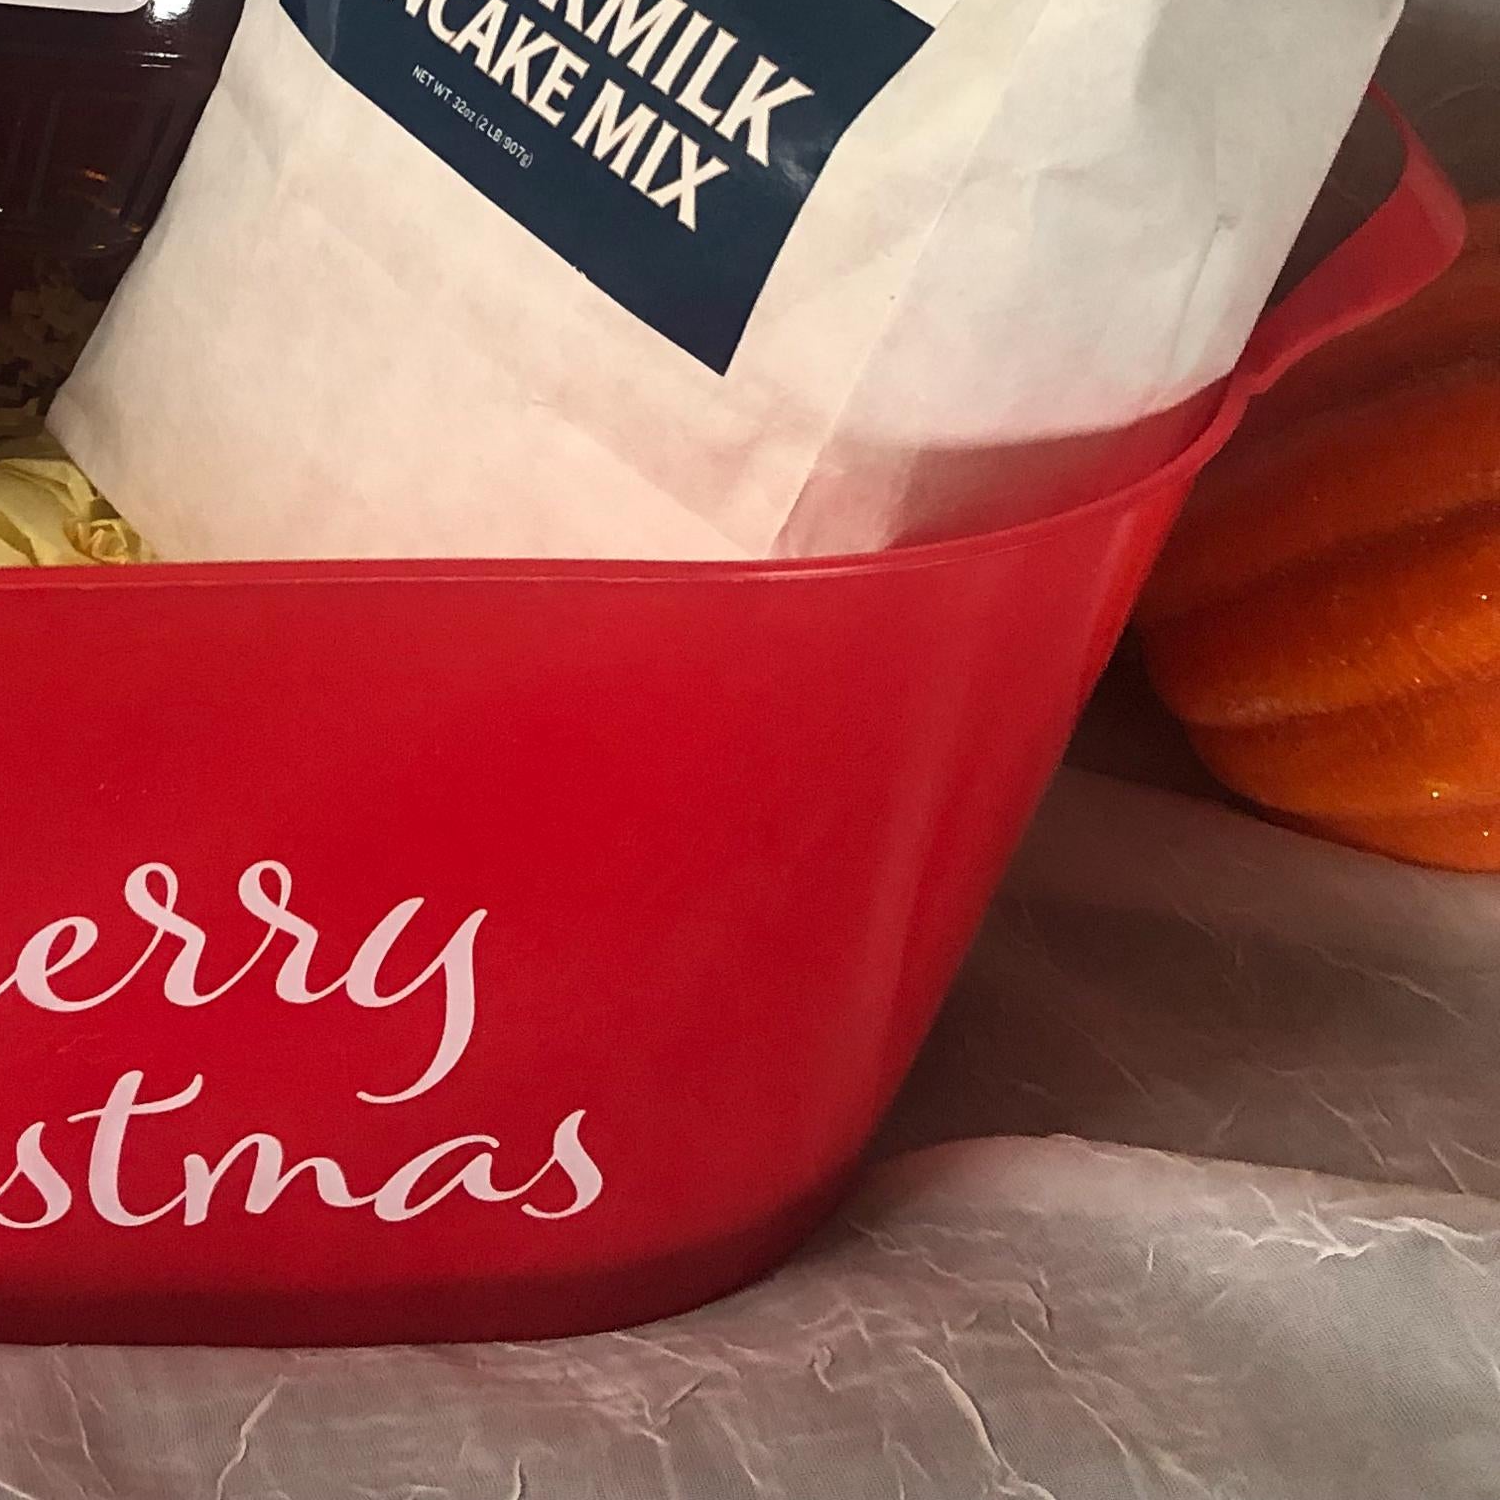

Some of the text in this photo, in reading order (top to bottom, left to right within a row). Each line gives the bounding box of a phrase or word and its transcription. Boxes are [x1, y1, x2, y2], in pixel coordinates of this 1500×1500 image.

[412, 64, 435, 88] NET
[452, 96, 476, 122] 32oz
[572, 79, 729, 232] MIX
